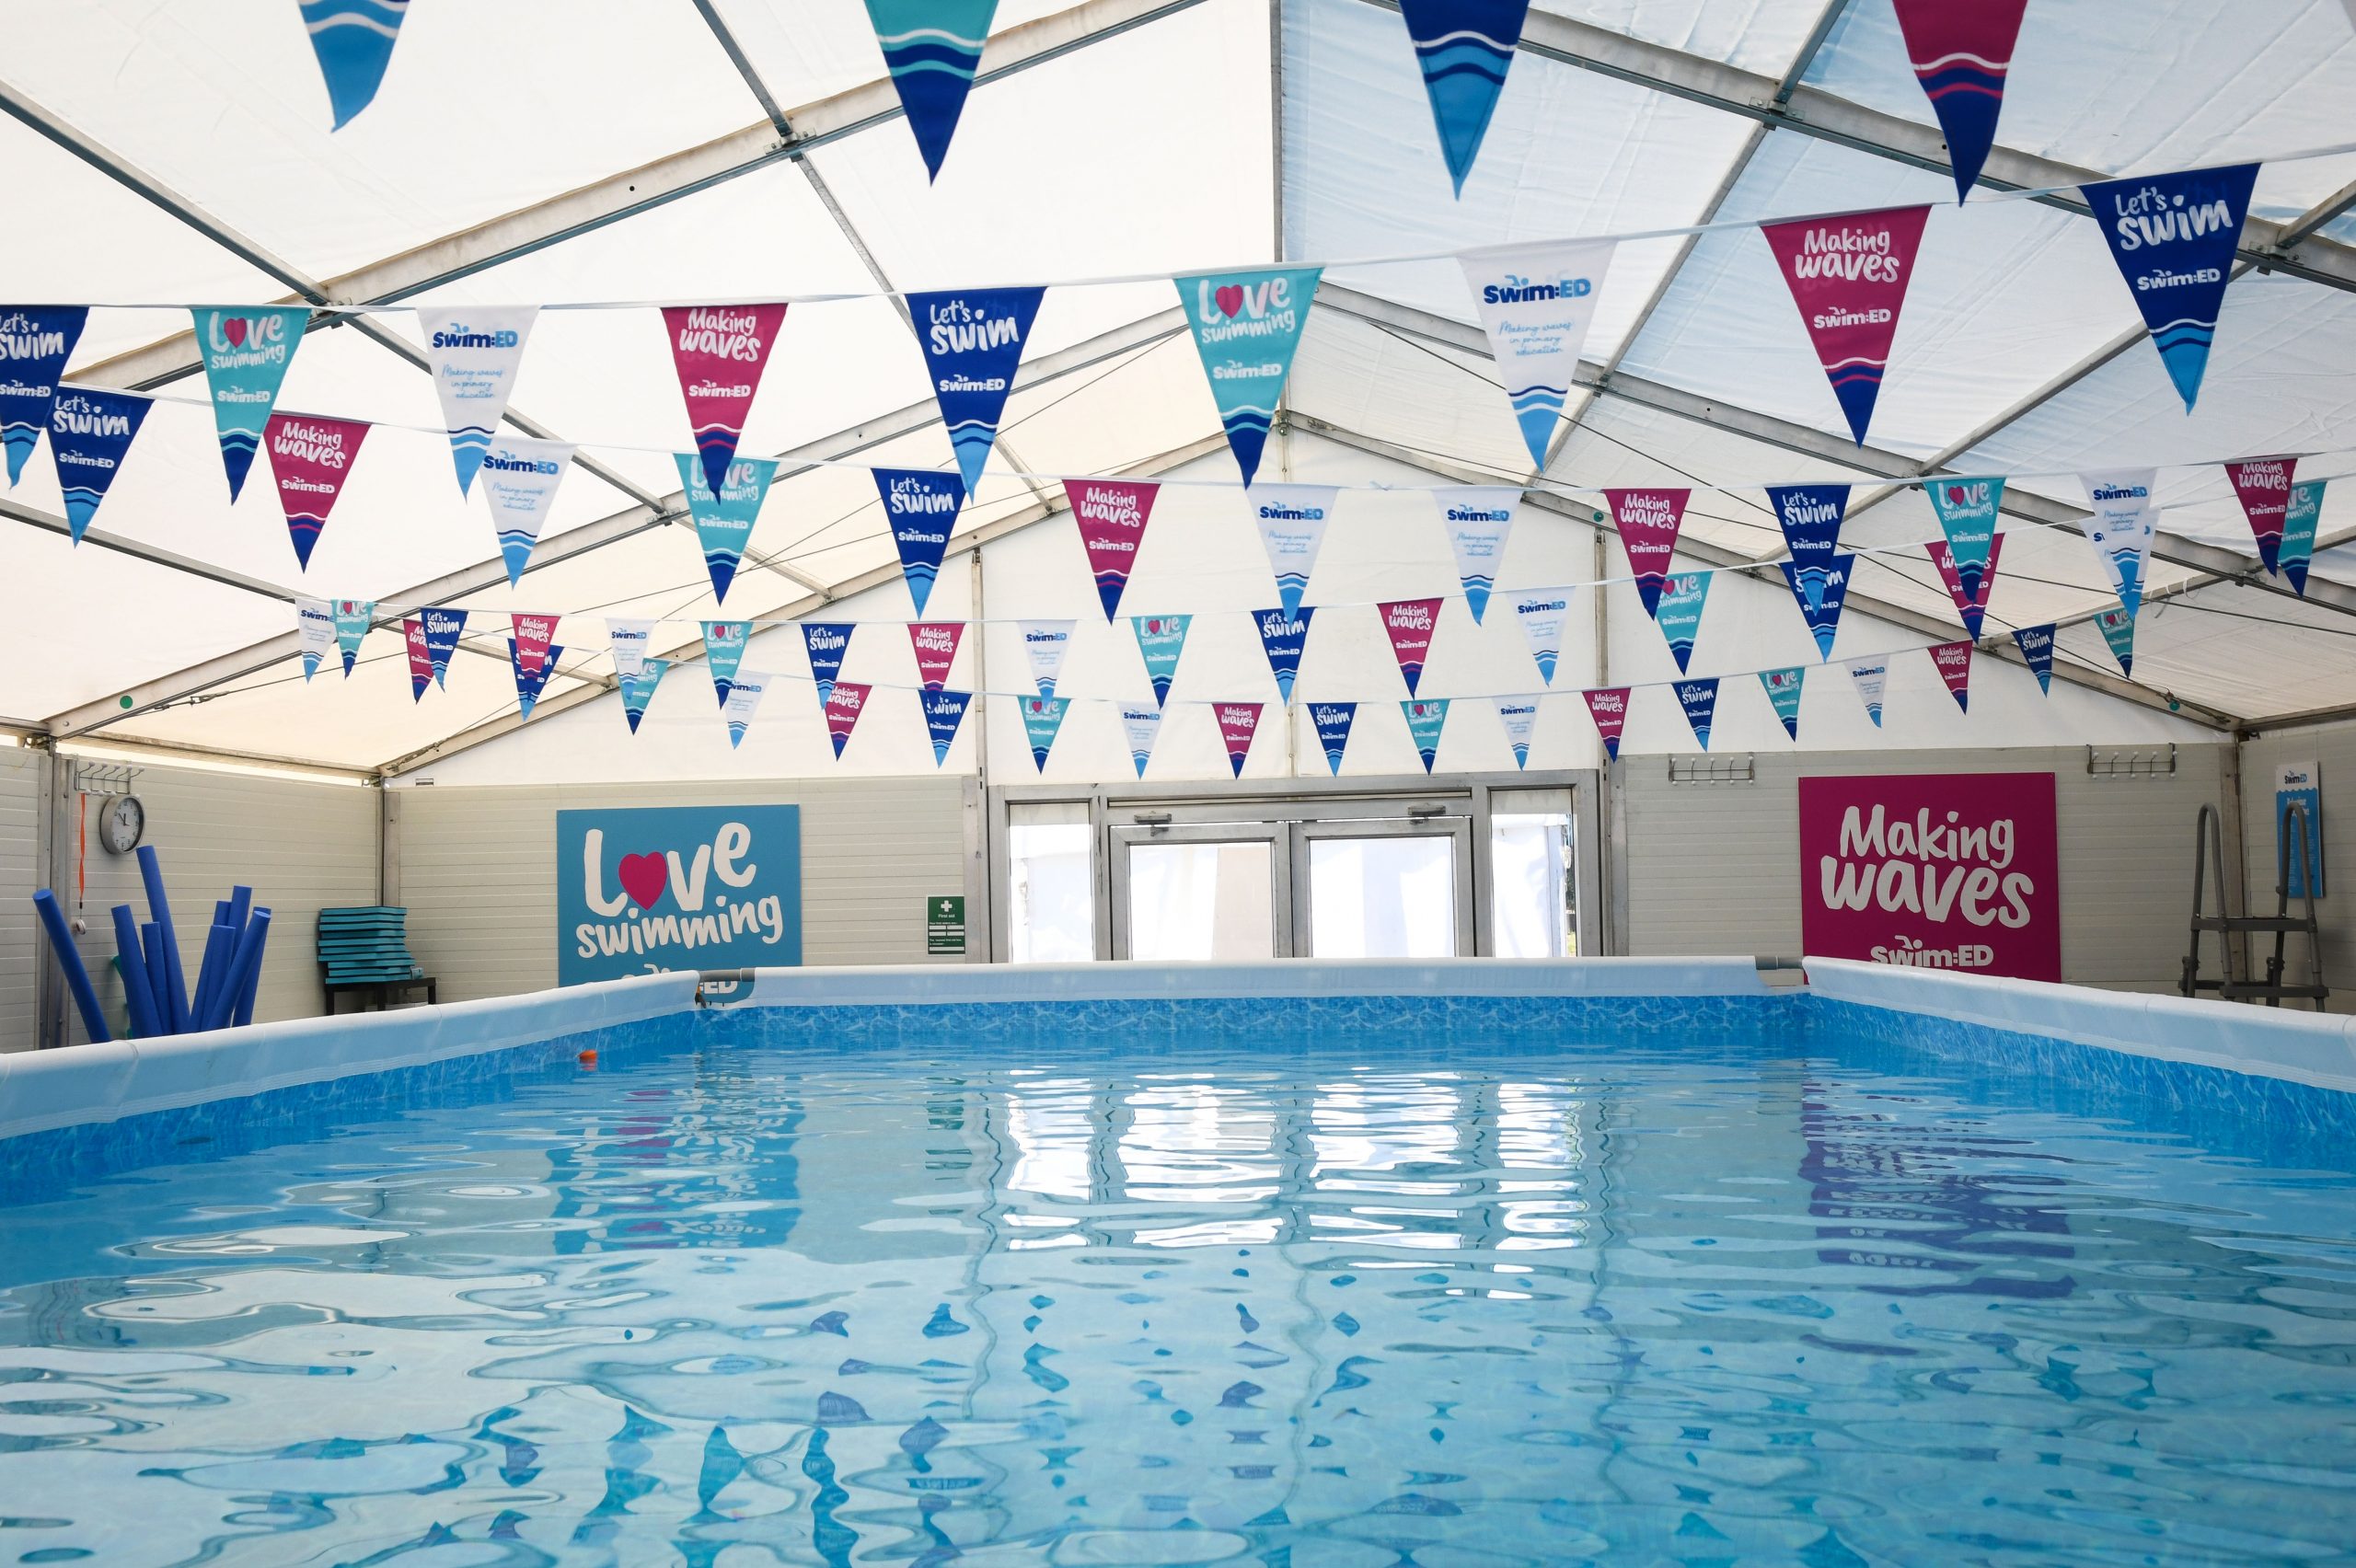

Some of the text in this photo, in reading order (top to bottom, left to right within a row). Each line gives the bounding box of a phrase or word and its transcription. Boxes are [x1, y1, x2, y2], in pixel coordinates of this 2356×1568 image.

[2115, 186, 2166, 216] Let's
[1804, 227, 1890, 255] Making
[1795, 252, 1900, 282] waves
[1484, 278, 1591, 304] Swim:ED
[2137, 269, 2221, 292] Swim:ED
[687, 307, 756, 337] Making
[930, 300, 971, 324] Let's
[1813, 308, 1891, 329] Swim:ED
[433, 326, 518, 348] Swim:ED
[1201, 309, 1296, 344] swimming
[679, 329, 761, 362] waves
[211, 344, 285, 369] swimming
[688, 382, 751, 398] Swim:ED
[940, 376, 1006, 391] Swim:ED
[55, 396, 89, 413] Let's
[283, 421, 342, 449] Making
[274, 435, 346, 469] waves
[483, 454, 559, 475] Swim:ED
[2243, 462, 2283, 475] Making
[890, 478, 920, 493] Let's
[2238, 473, 2288, 490] waves
[1086, 487, 1137, 510] Making
[1624, 493, 1670, 513] Making
[1782, 491, 1808, 507] Let's
[1080, 501, 1141, 528] waves
[1259, 504, 1323, 520] Swim:ED
[1448, 507, 1509, 522] Swim:ED
[1620, 507, 1676, 530] waves
[1943, 501, 1993, 521] swimming
[1263, 612, 1282, 625] Let's
[1392, 605, 1428, 618] Making
[810, 627, 826, 637] Let's
[920, 627, 951, 640] Making
[1389, 616, 1432, 630] waves
[916, 637, 953, 652] waves
[1592, 700, 1623, 712] waves
[1840, 803, 2015, 870] Making
[1820, 855, 2034, 928] waves
[575, 895, 783, 958] swimming
[1870, 939, 1994, 967] Swim:ED
